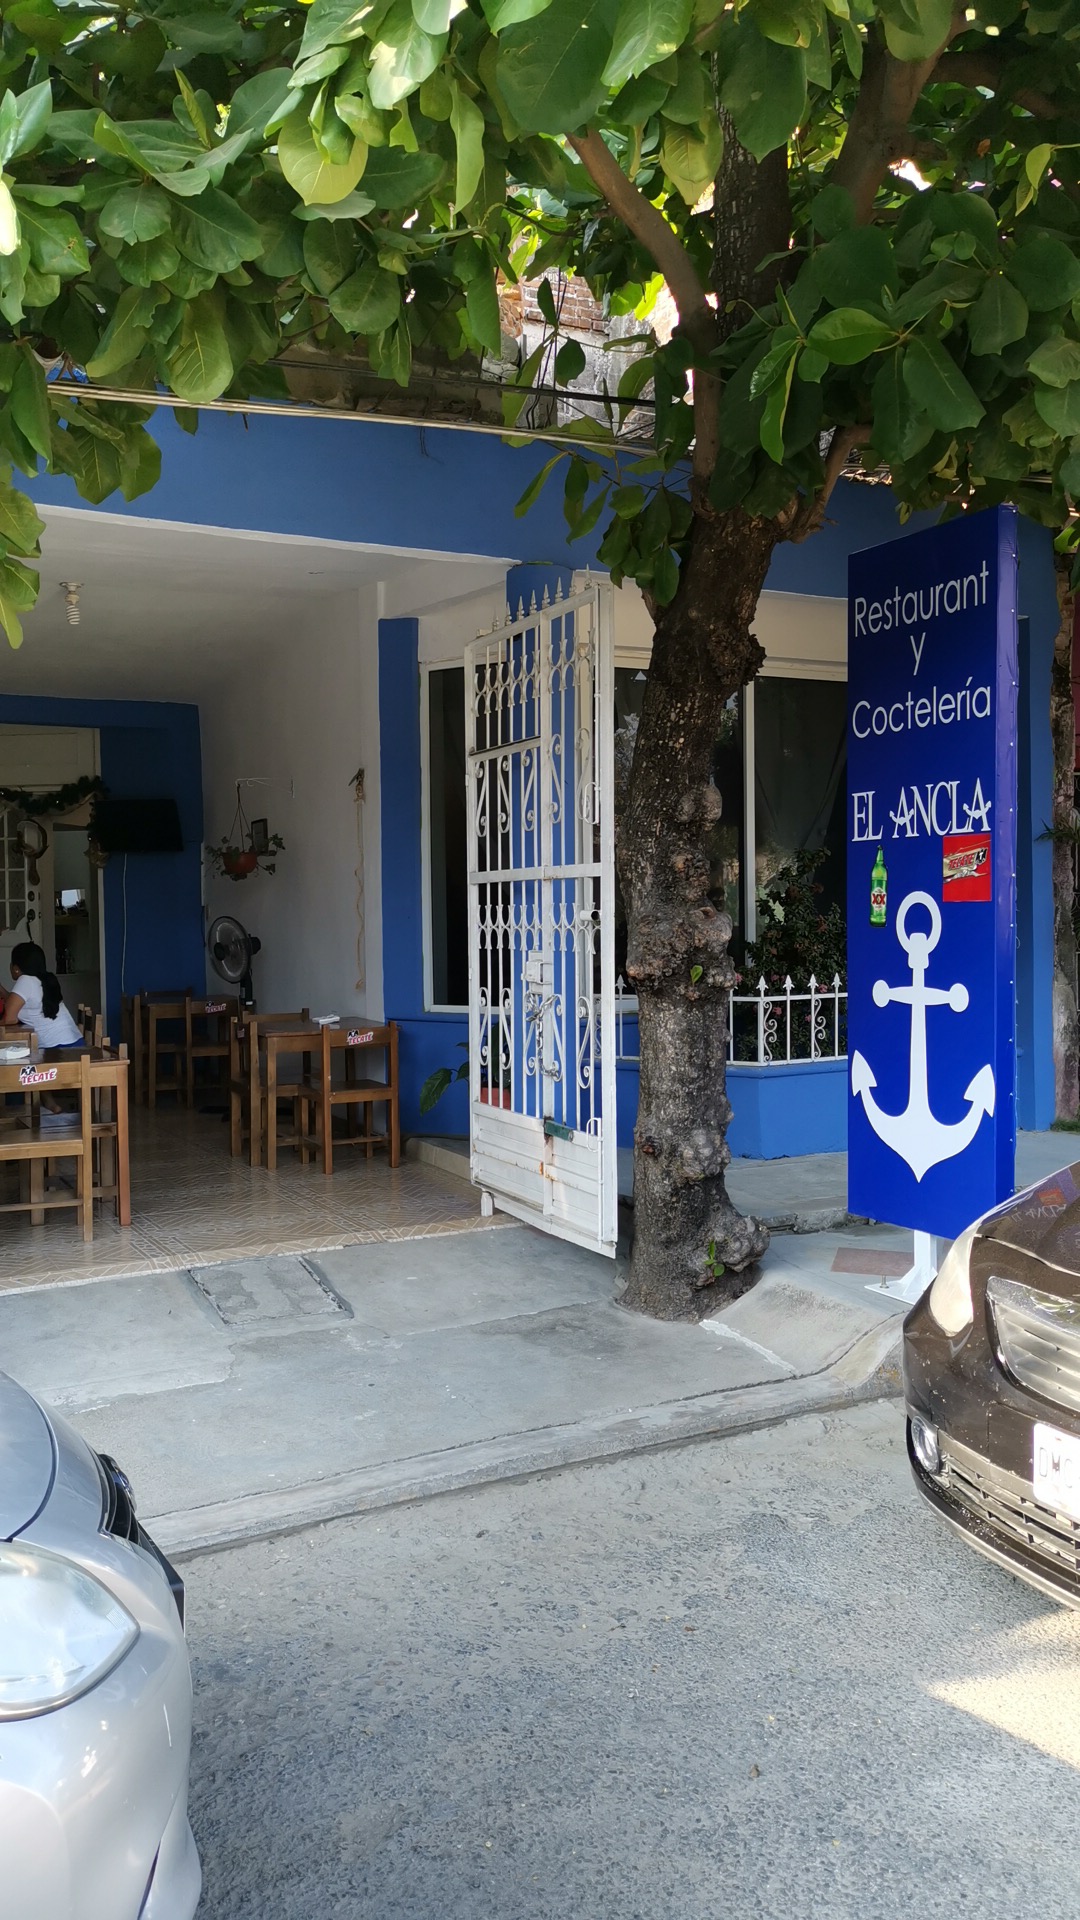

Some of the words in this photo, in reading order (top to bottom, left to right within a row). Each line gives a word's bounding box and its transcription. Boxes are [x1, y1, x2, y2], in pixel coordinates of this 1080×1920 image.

[854, 560, 990, 638] Restaurant
[909, 631, 927, 676] y
[852, 676, 992, 739] Coctelería
[851, 790, 884, 842] EL
[889, 776, 993, 839] ANCLA
[347, 1032, 374, 1046] TECATE
[20, 1069, 58, 1085] TECATE
